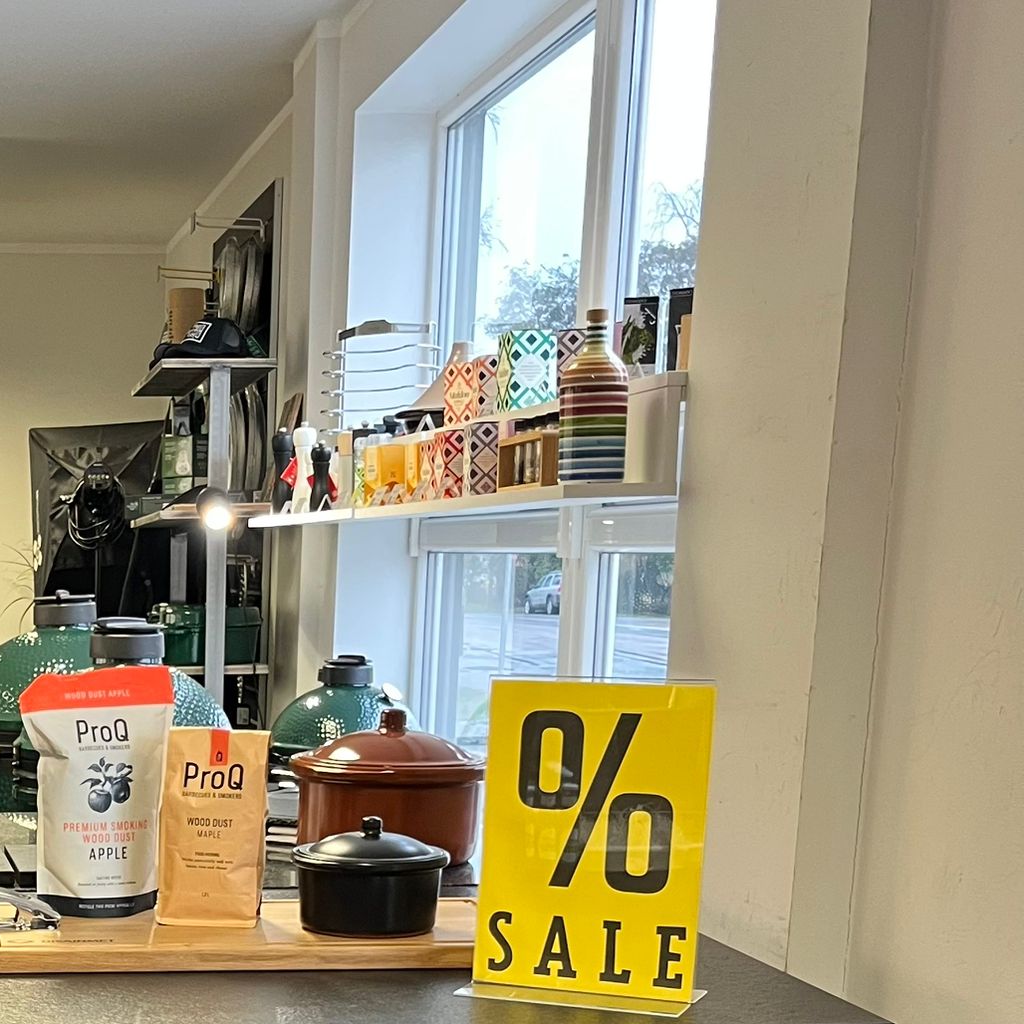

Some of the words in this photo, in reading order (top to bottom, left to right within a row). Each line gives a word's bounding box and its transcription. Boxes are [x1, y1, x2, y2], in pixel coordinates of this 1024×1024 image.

[64, 691, 87, 700] WOOD
[88, 689, 106, 699] DUST
[108, 688, 130, 698] APPLE
[76, 718, 129, 743] ProQ
[183, 761, 244, 791] ProQ
[63, 822, 107, 832] PREMIUM
[187, 817, 210, 827] WOOD
[212, 818, 233, 828] DUST
[82, 833, 111, 843] WOOD
[114, 832, 136, 842] DUST
[197, 830, 221, 839] MAPLE
[89, 846, 128, 860] APPLE
[487, 911, 687, 989] SALE
